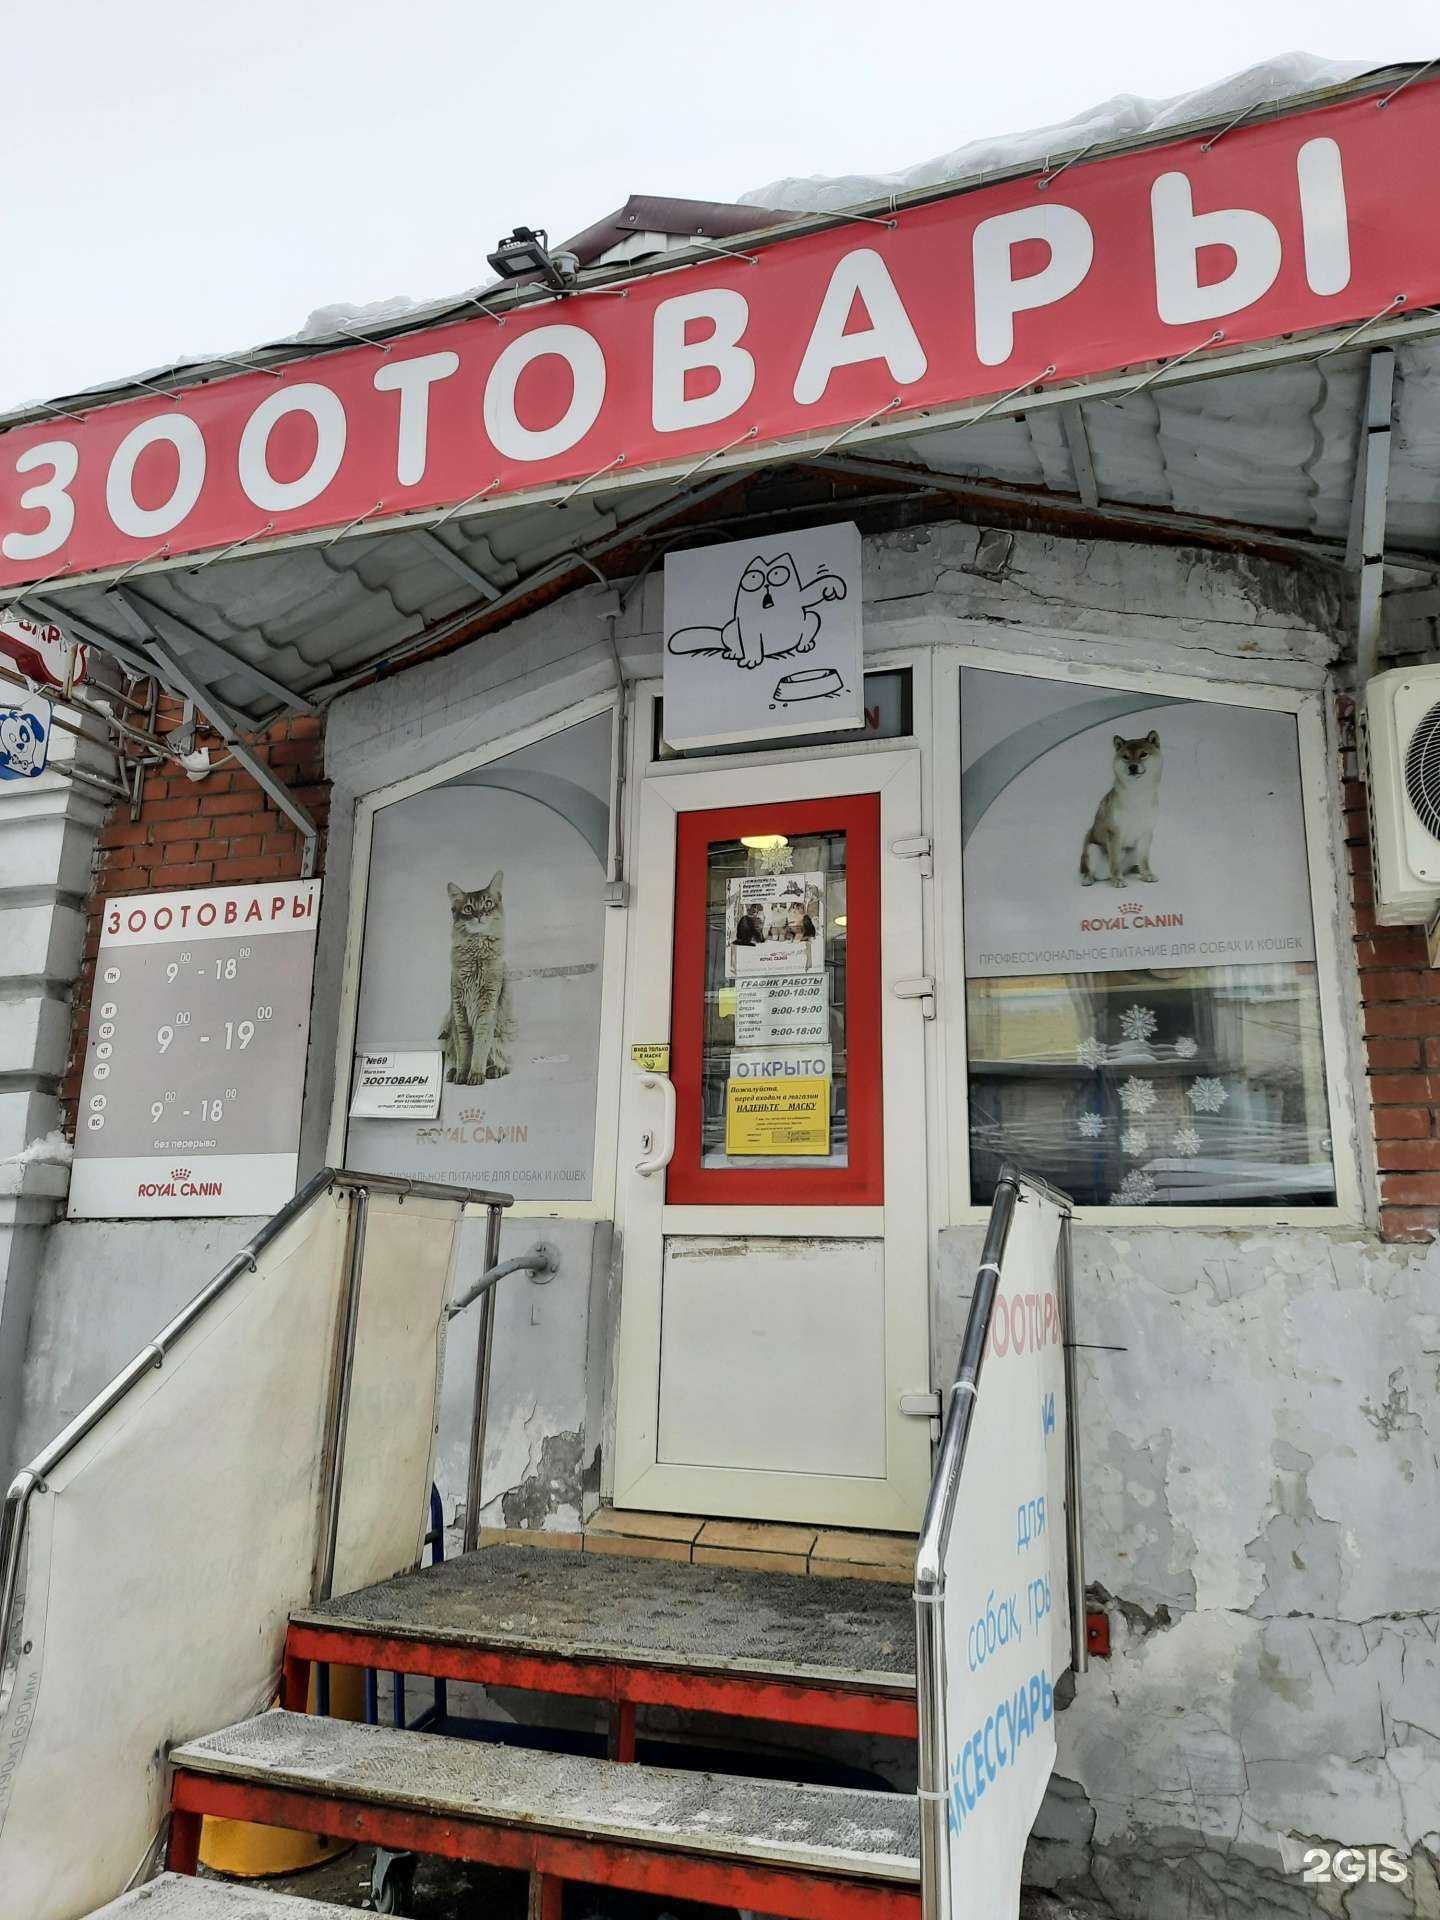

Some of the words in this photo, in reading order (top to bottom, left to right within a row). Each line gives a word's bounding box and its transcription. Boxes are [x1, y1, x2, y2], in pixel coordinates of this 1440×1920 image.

[3, 137, 1352, 561] ЗООТОВАРЫ
[108, 894, 313, 934] ЗООТОВАРЫ
[1080, 913, 1128, 932] ROYAL
[1133, 913, 1184, 929] CANIN
[979, 946, 1108, 965] ПРОФЕССИОНАЛЬНОЕ
[1111, 943, 1168, 960] ПИТАНИЕ
[1199, 939, 1242, 955] СОБАК
[1257, 936, 1304, 951] КОШЕК
[782, 977, 823, 986] РАБОТЫ
[771, 1005, 823, 1015] 9:00-19:00
[736, 1059, 826, 1078] ОТКРЫТО
[362, 1075, 429, 1086] ЗООТОВАРЫ
[788, 1102, 817, 1111] МАСКУ
[138, 1183, 177, 1197] ROYAL
[180, 1182, 223, 1197] CANIN
